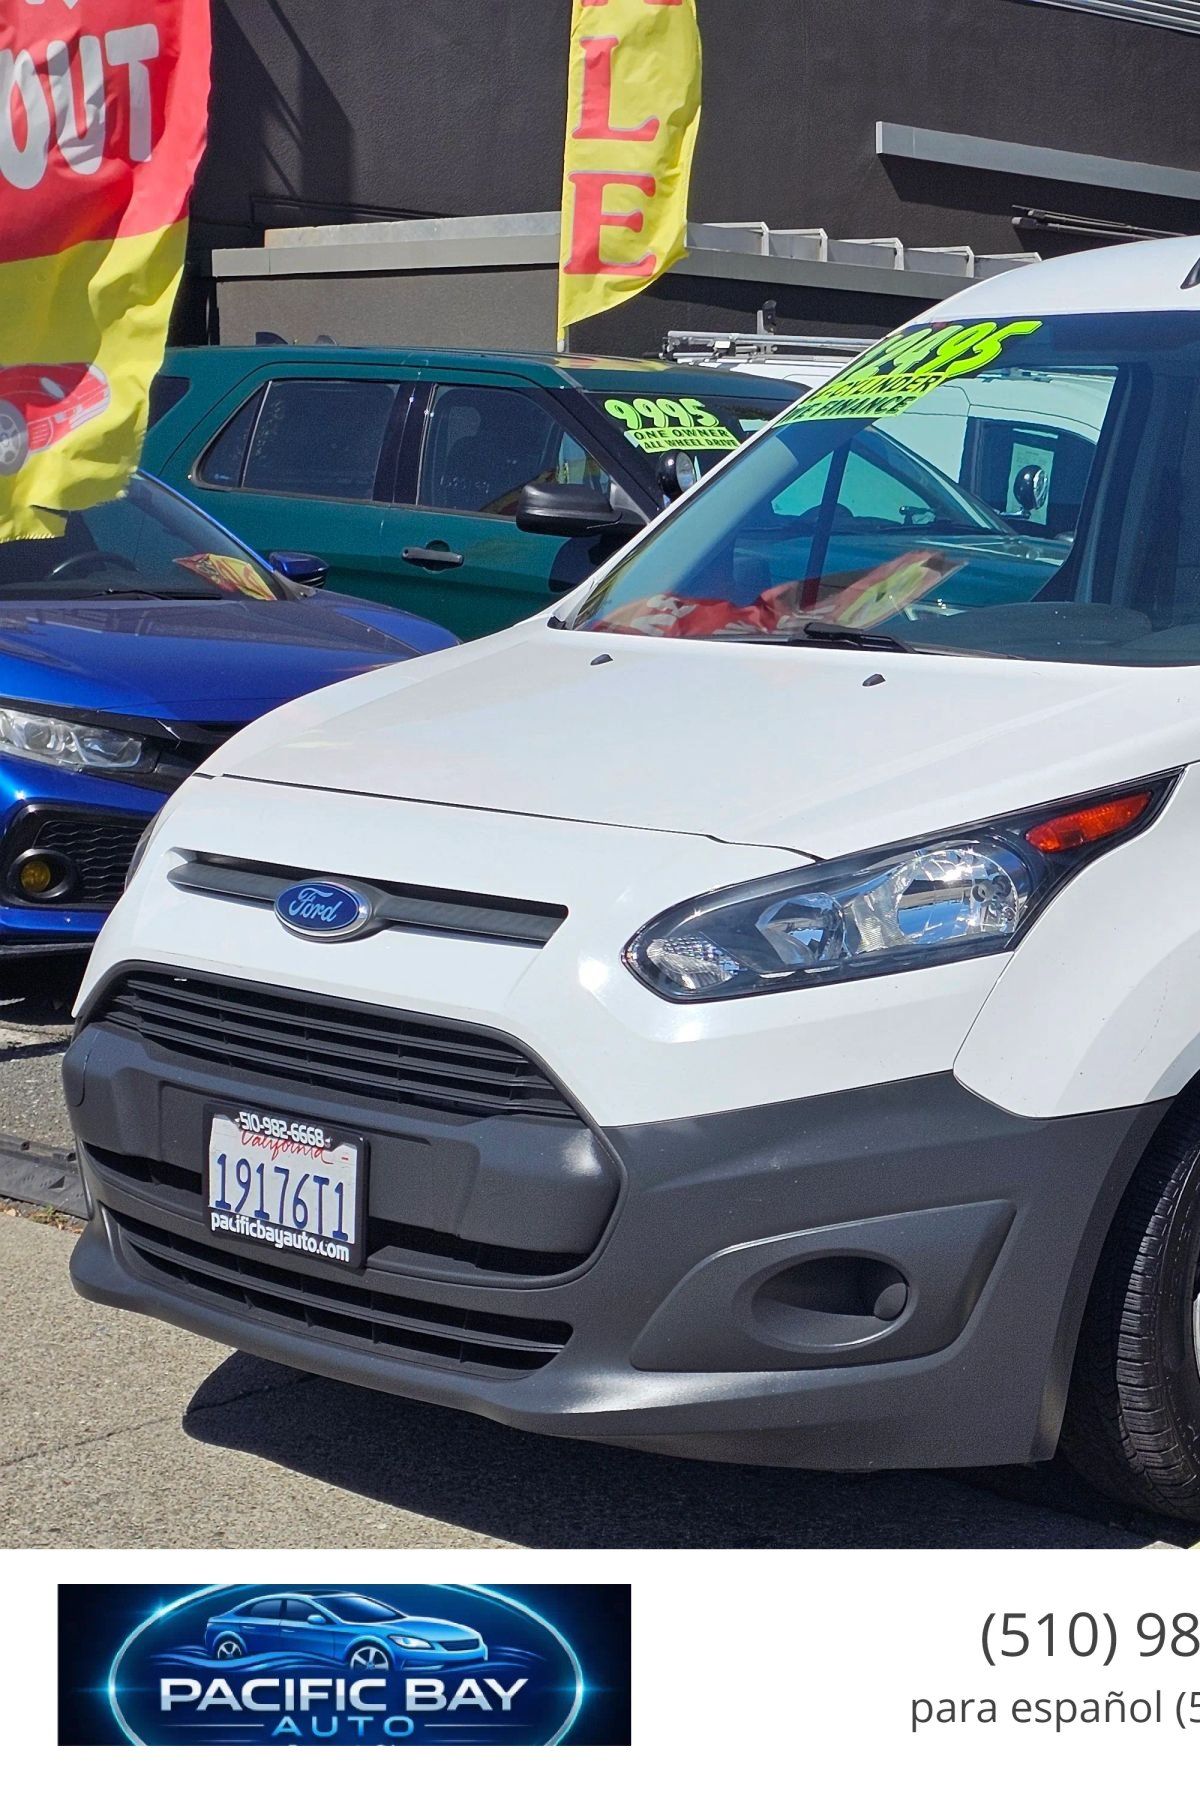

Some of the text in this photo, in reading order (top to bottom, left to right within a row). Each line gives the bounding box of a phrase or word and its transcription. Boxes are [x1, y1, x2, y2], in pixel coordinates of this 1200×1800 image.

[604, 398, 719, 430] 9995
[810, 395, 919, 417] FINANCE
[634, 428, 729, 440] ONE OWNER
[644, 438, 739, 450] ALL WHEEL DRIVE
[288, 887, 343, 922] Ford
[239, 1111, 325, 1148] 510-982-6668
[215, 1153, 349, 1241] 19176T1
[211, 1212, 350, 1262] pacificbayauto.com
